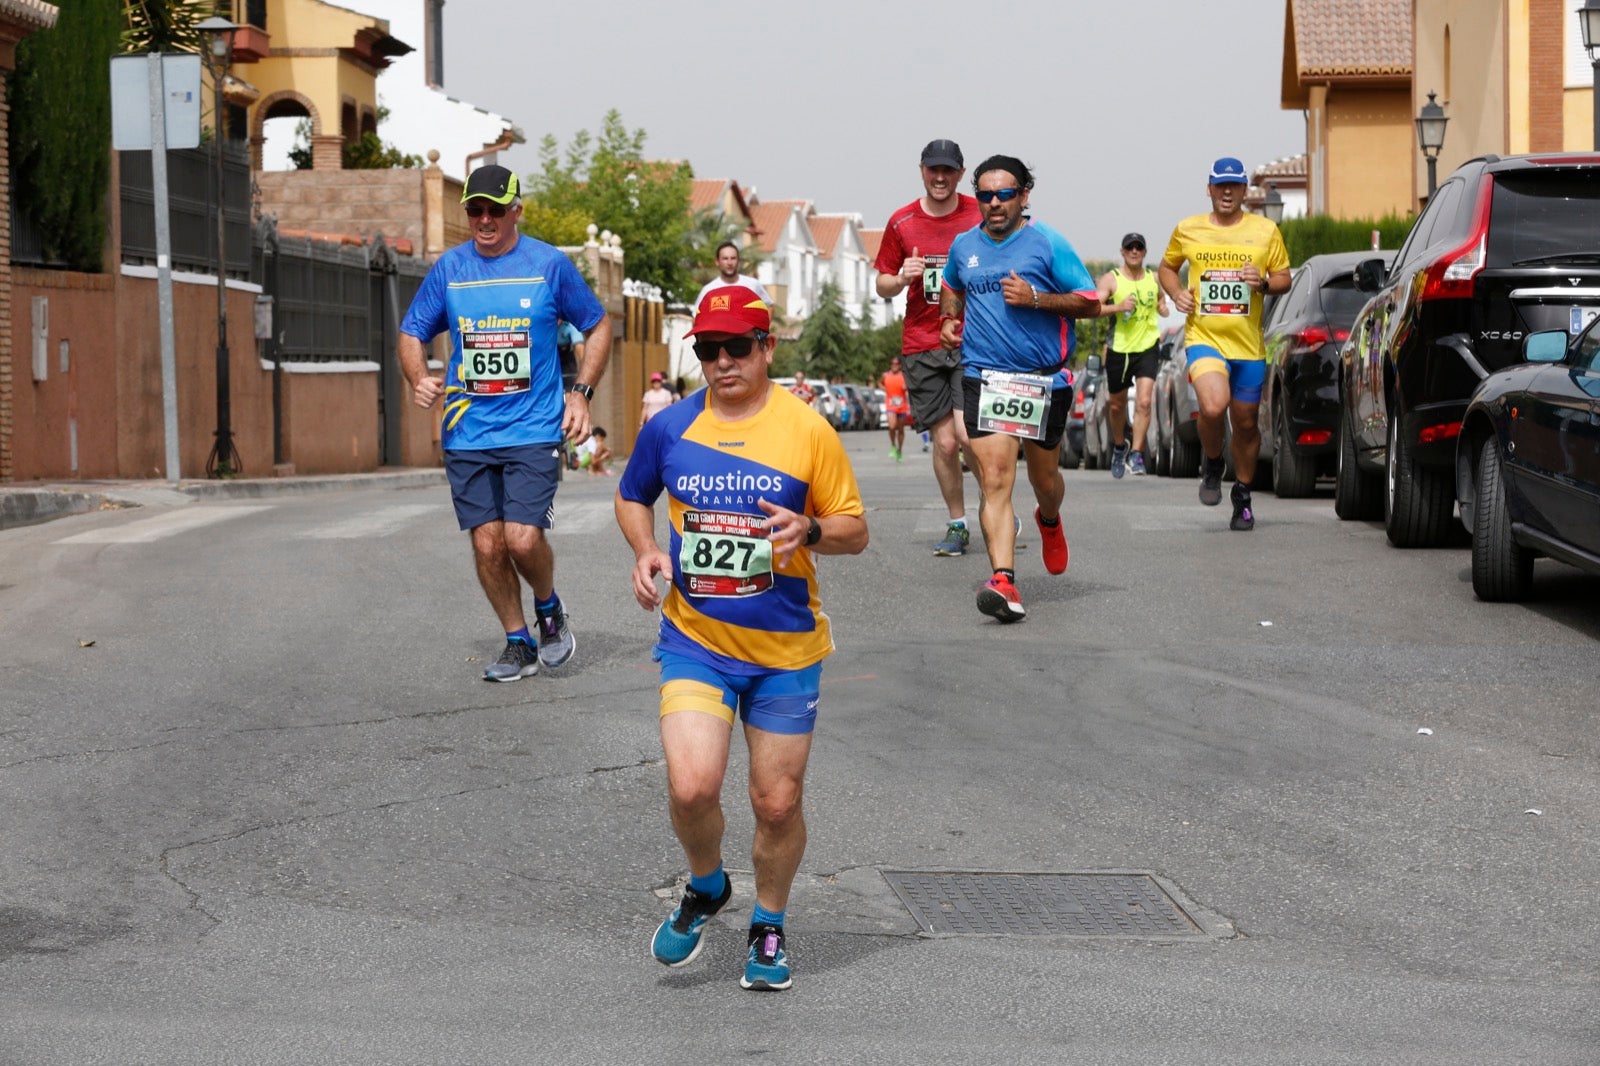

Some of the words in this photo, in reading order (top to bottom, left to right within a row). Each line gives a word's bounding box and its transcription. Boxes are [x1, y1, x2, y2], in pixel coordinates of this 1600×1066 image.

[1196, 251, 1253, 263] agustinos
[1208, 284, 1242, 300] 806
[477, 315, 531, 331] olimpo
[1480, 331, 1500, 339] XC
[1502, 331, 1522, 339] 60
[473, 351, 519, 375] 650
[992, 396, 1034, 419] 659
[677, 470, 782, 497] agustinos
[700, 513, 716, 524] GRAN
[716, 514, 738, 526] PREMIO
[693, 537, 756, 572] 827
